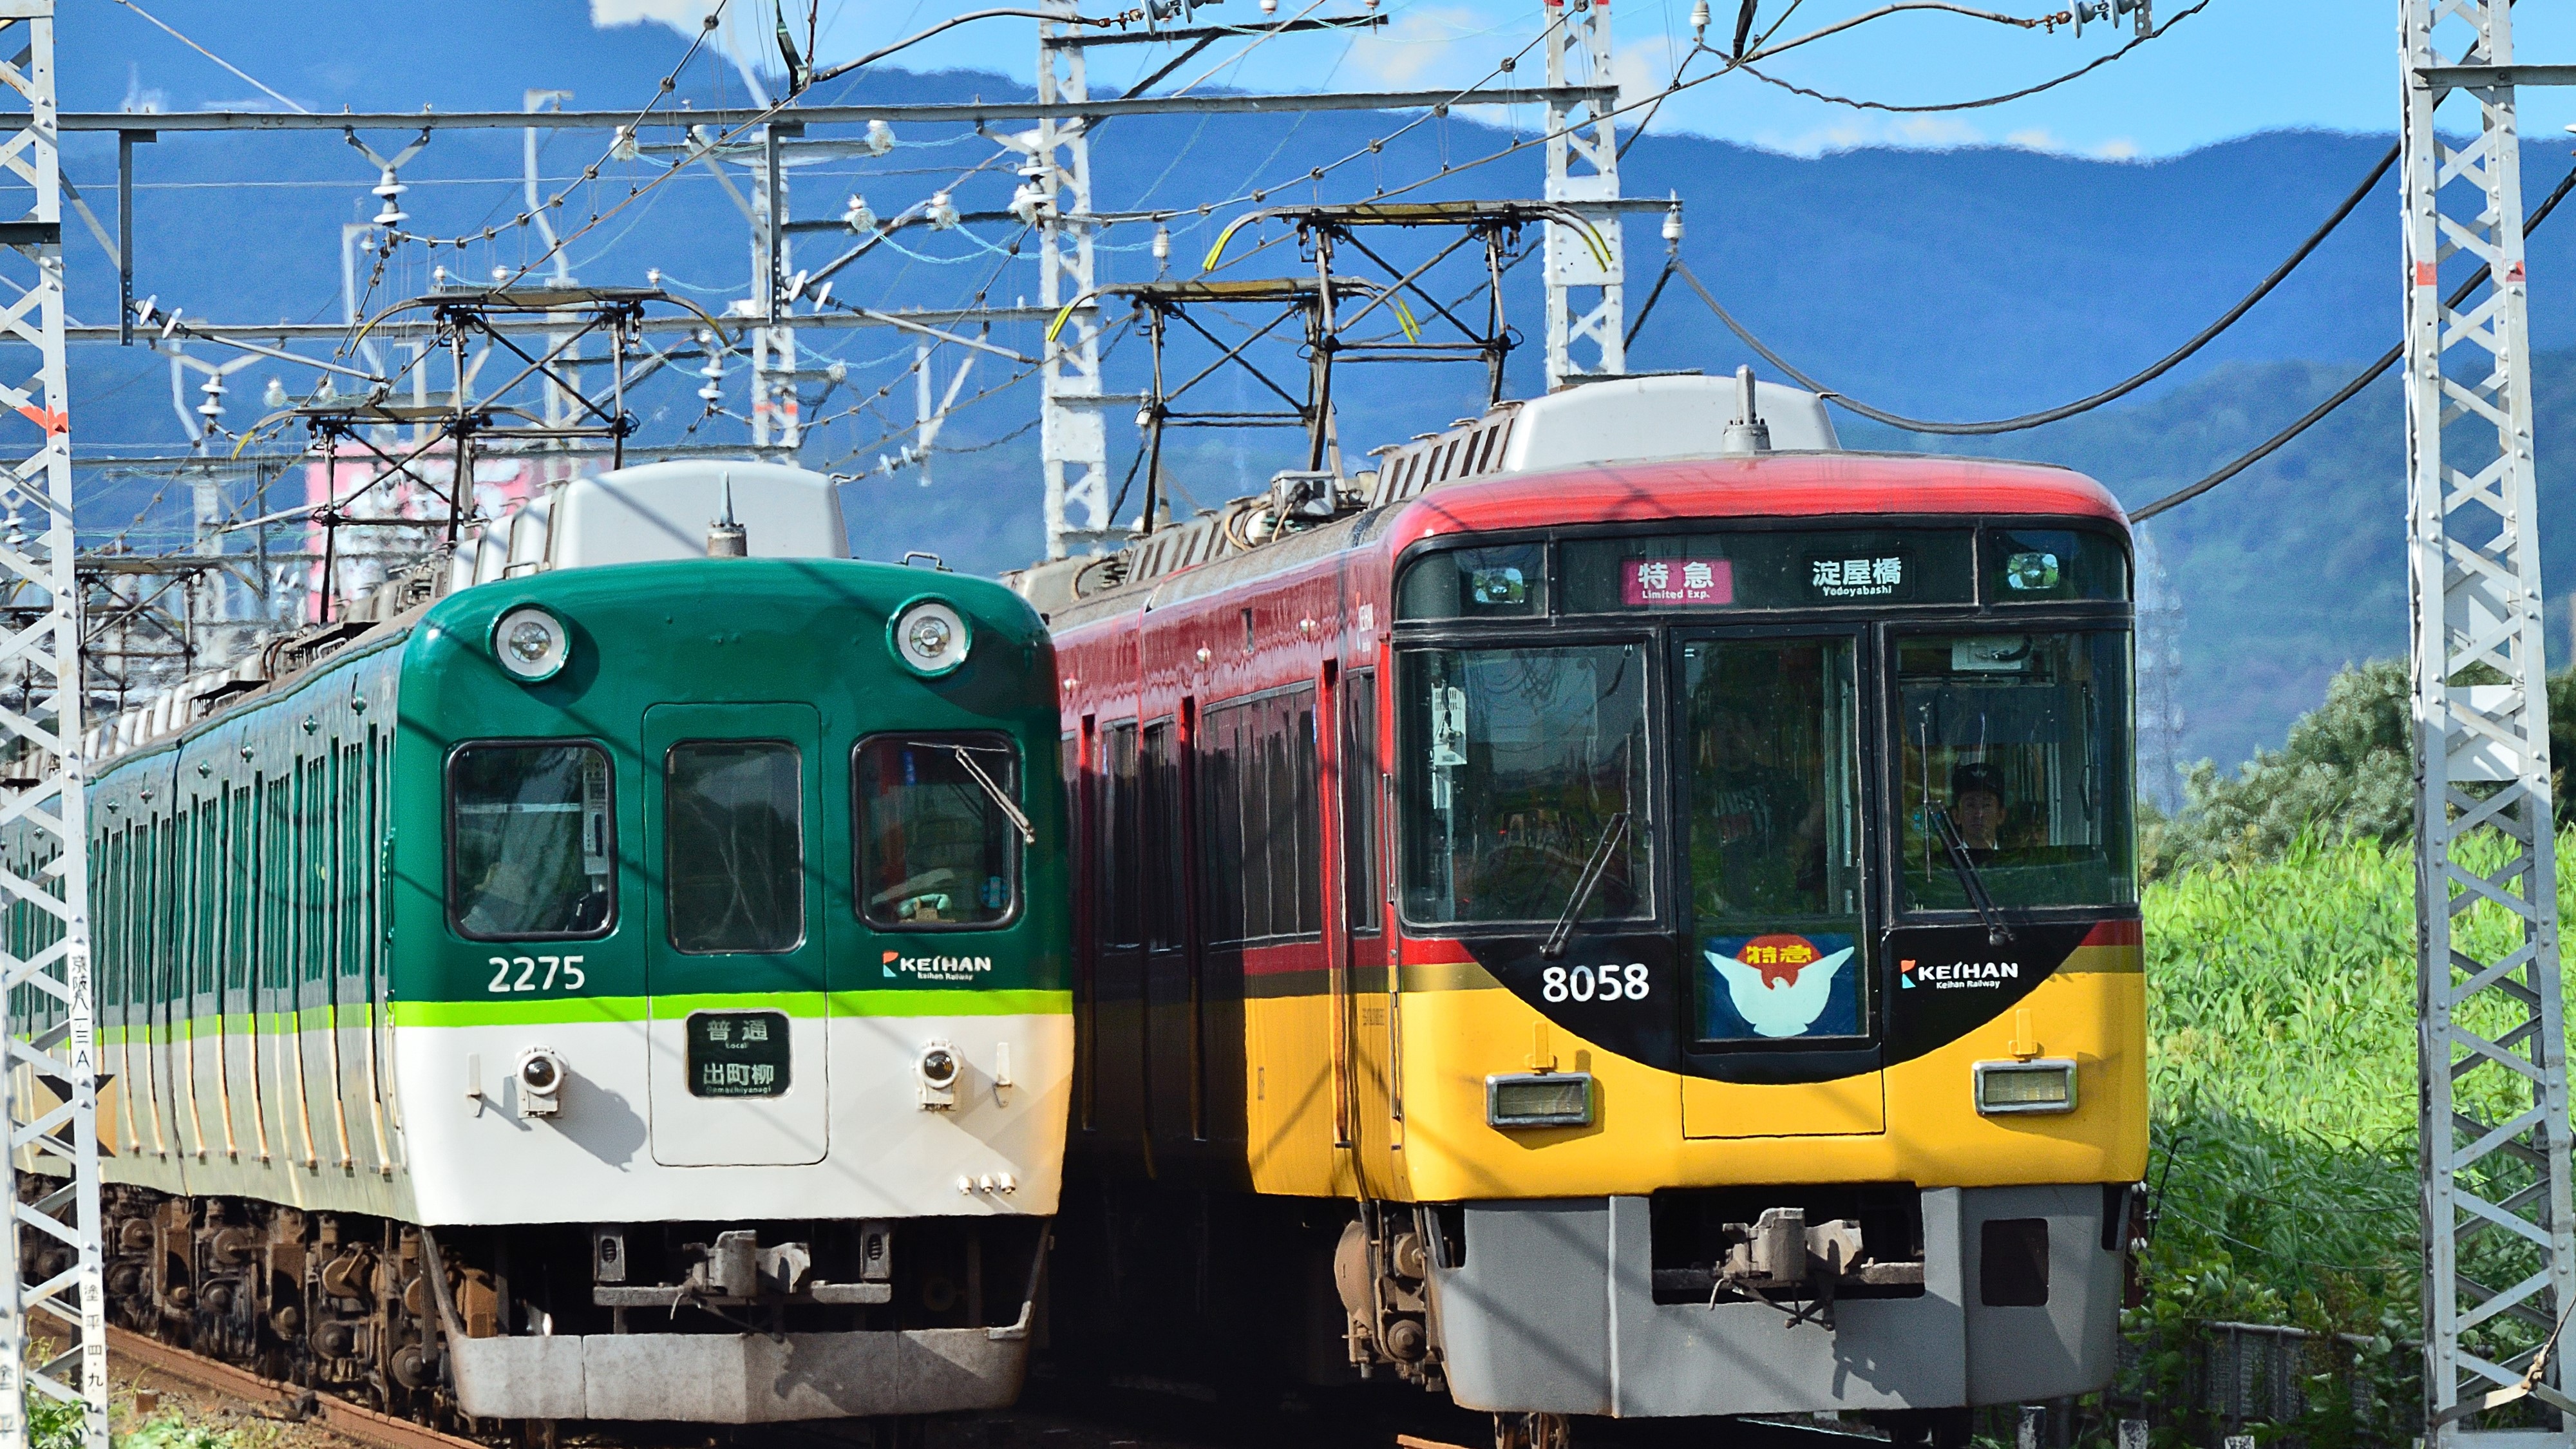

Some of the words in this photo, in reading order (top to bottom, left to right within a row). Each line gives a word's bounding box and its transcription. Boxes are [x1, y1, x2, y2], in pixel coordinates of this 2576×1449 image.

[1637, 561, 1715, 589] 特急
[1812, 556, 1902, 587] 淀屋橋
[1642, 589, 1683, 599] Limited
[1687, 589, 1710, 600] Exp.
[1823, 585, 1892, 597] Yodoyabashi
[900, 955, 991, 972] KEIHAN
[1746, 944, 1812, 964] 特急
[488, 955, 585, 992] 2275
[917, 971, 944, 980] Keihan
[945, 972, 974, 981] Railway
[1918, 961, 2018, 981] KEIHAN
[1542, 963, 1650, 1003] 8058
[1936, 980, 1965, 989] Keihan
[1967, 980, 2001, 989] Railway
[706, 1019, 768, 1041] 普通
[703, 1062, 774, 1086] 出町柳
